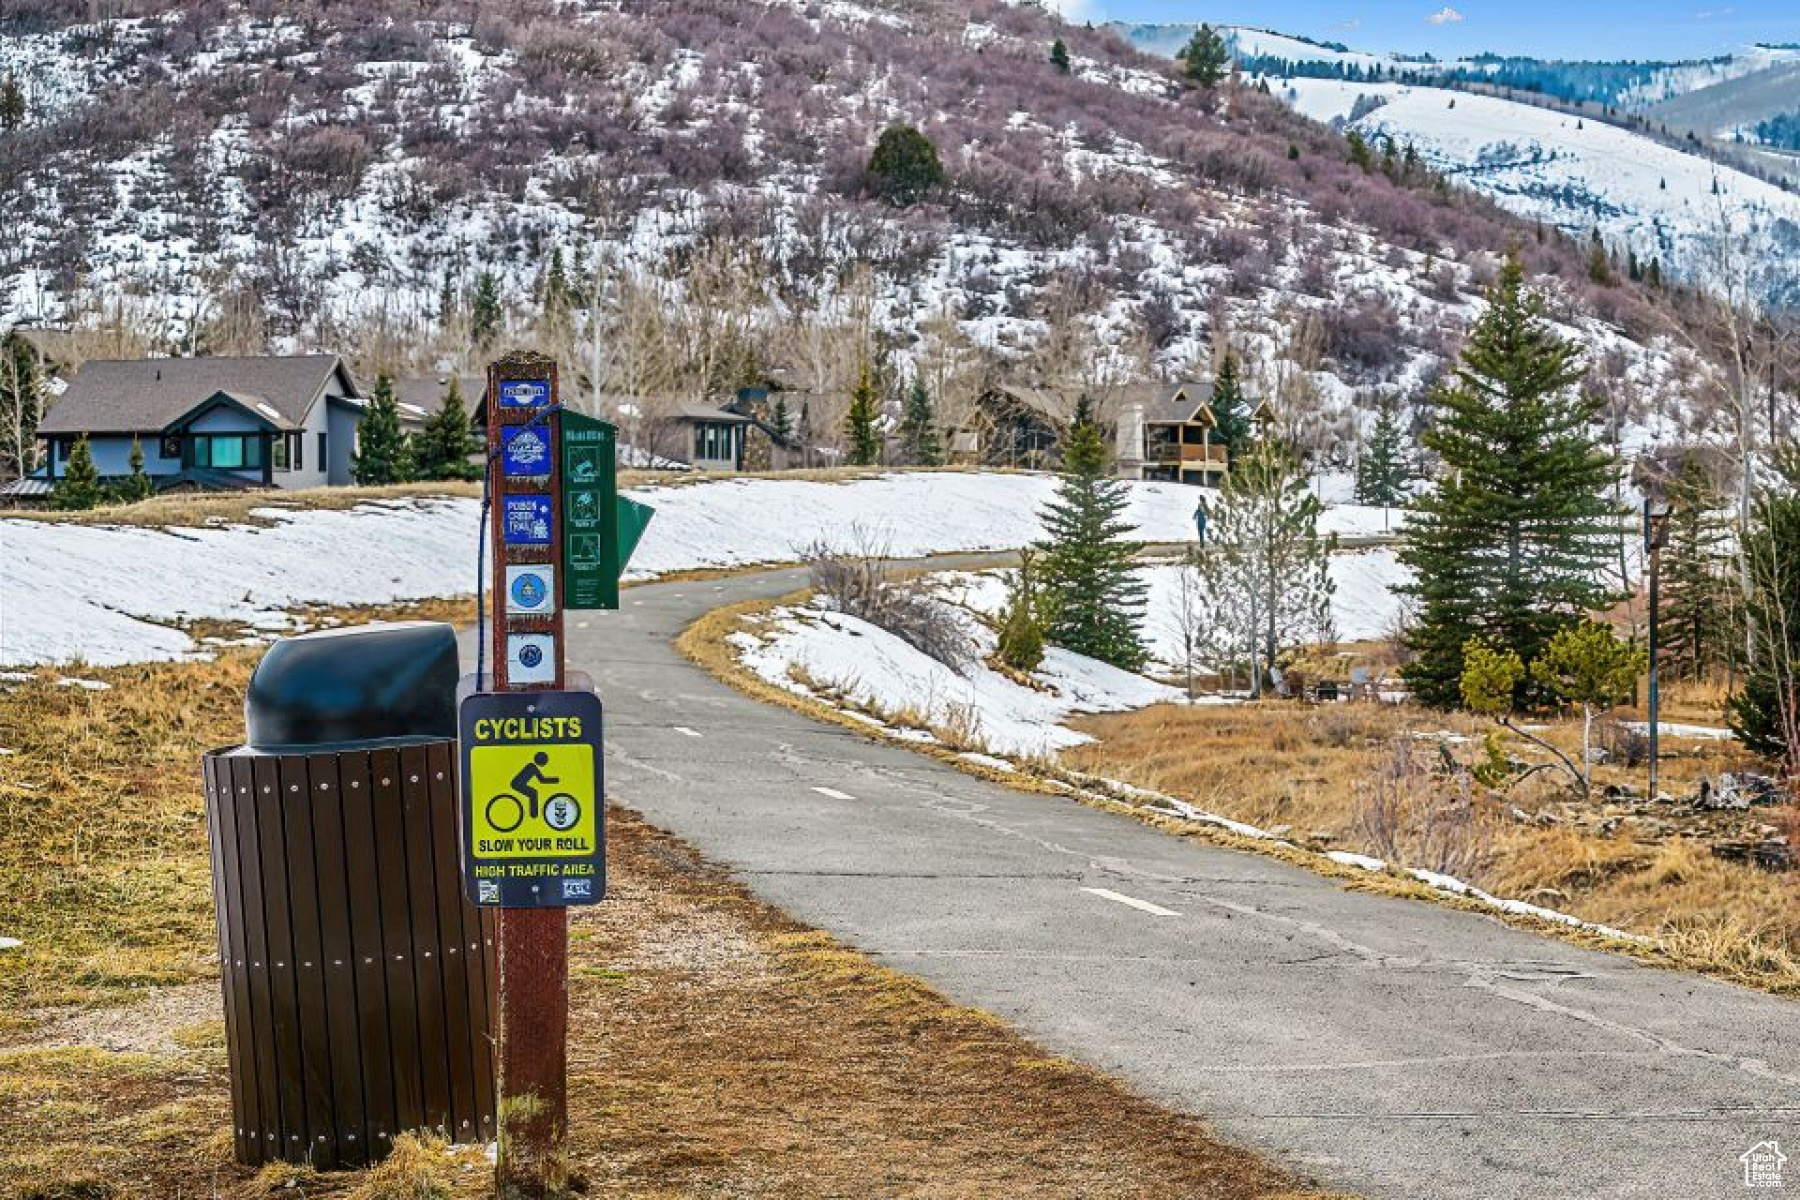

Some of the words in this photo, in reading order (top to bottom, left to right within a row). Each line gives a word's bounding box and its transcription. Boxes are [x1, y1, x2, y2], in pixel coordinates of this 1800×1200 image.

[508, 511, 535, 520] CREEK
[509, 520, 530, 533] TRAIL
[474, 716, 584, 740] CYCLISTS
[479, 838, 514, 852] SLOW
[517, 838, 552, 851] YOUR
[556, 837, 589, 850] ROLL
[475, 865, 505, 878] HIGH
[508, 864, 559, 877] TRAFFIC
[562, 863, 595, 876] AREA
